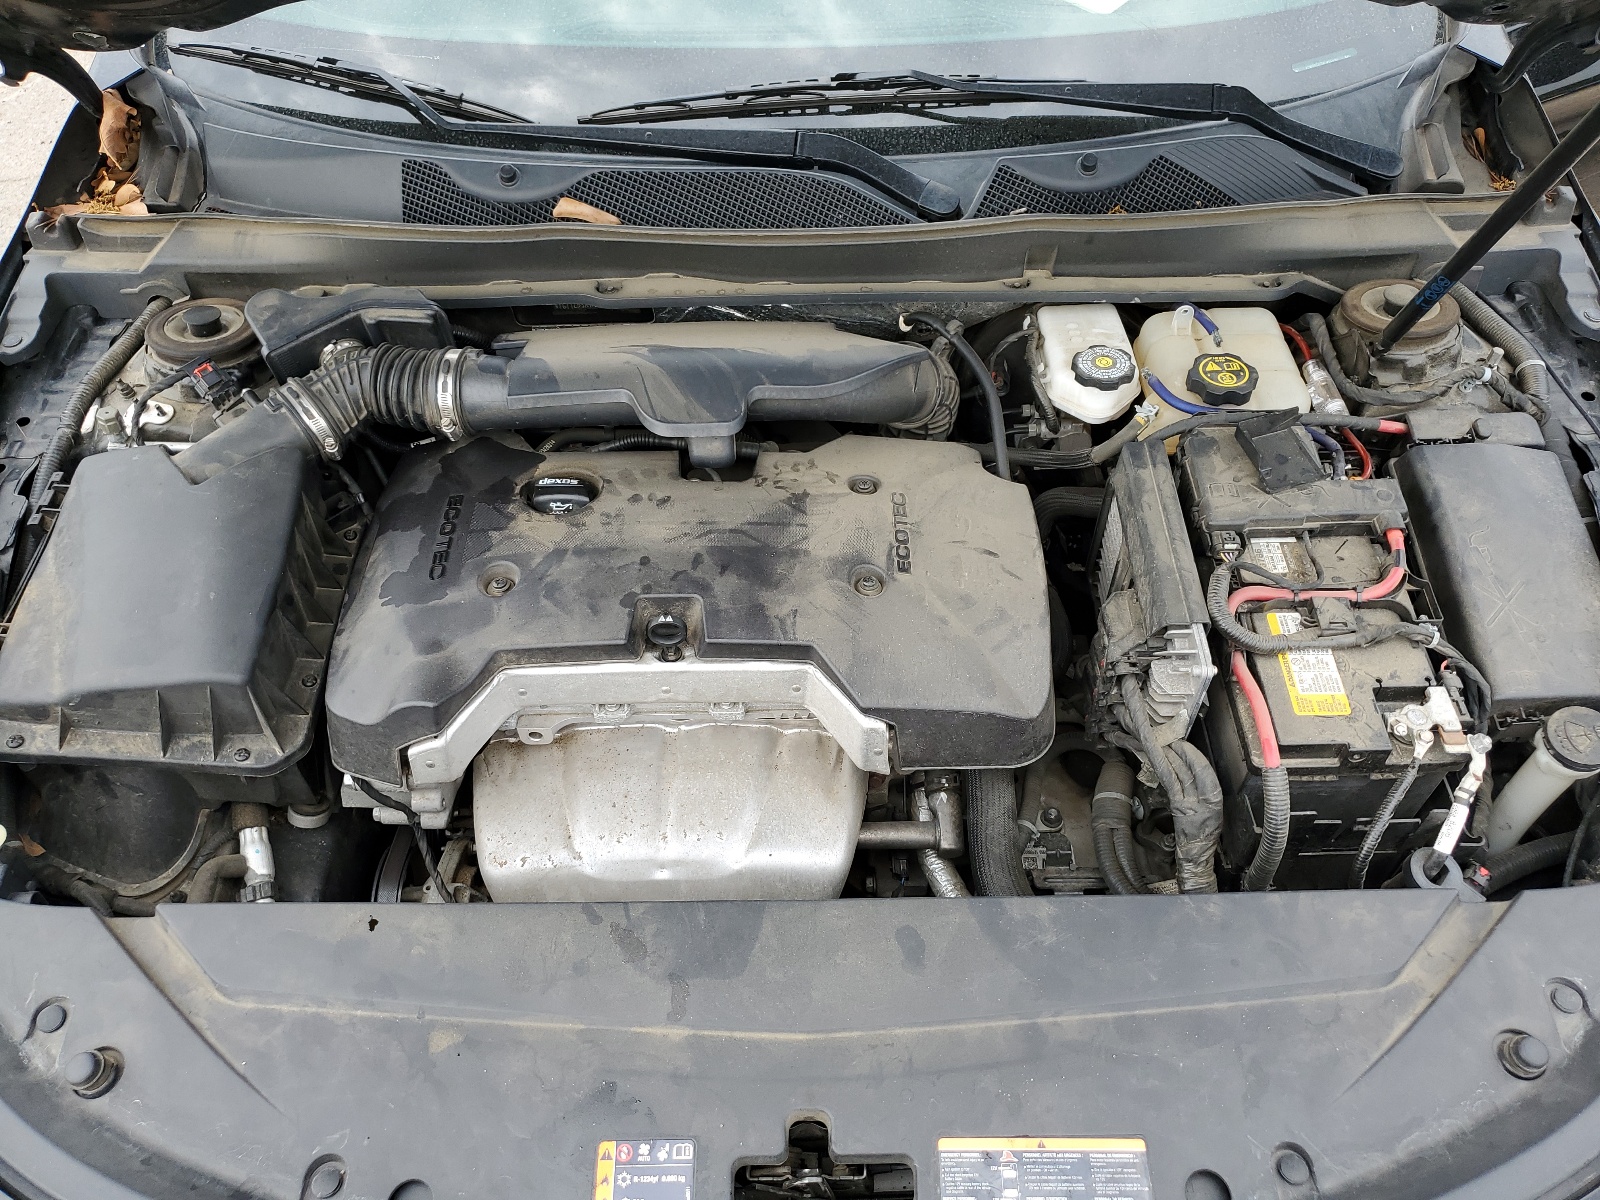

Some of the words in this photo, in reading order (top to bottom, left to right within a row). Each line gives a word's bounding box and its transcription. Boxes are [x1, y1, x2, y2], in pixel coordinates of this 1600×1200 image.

[539, 477, 579, 485] dexos
[429, 494, 464, 580] ECOTEC
[891, 492, 912, 575] ECOTEC
